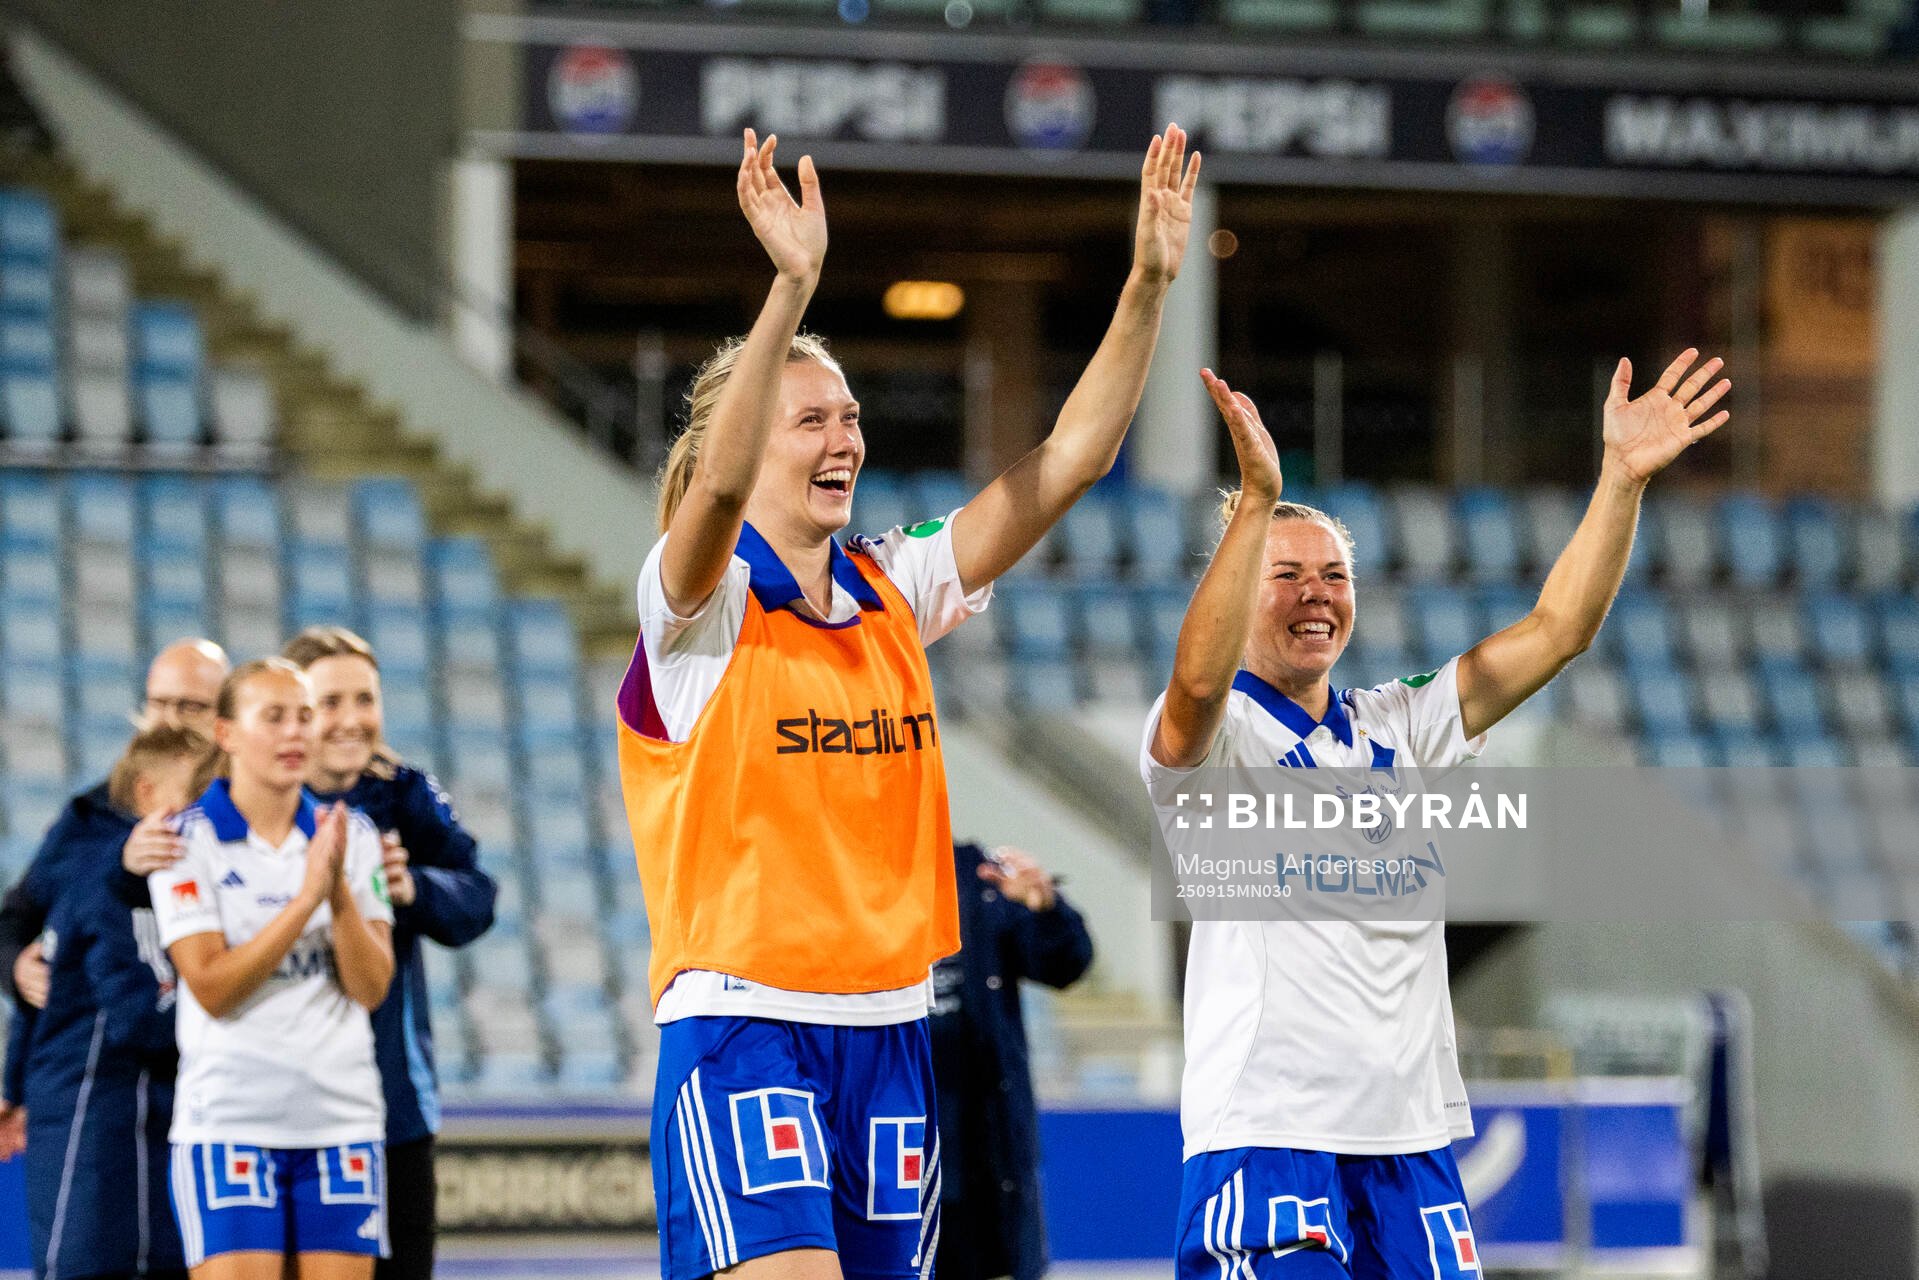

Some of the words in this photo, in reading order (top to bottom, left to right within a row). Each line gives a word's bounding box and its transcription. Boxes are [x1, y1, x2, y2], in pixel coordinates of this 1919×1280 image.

[704, 56, 946, 140] PEPSI
[1154, 74, 1391, 154] PEPSI
[776, 708, 935, 755] stadium
